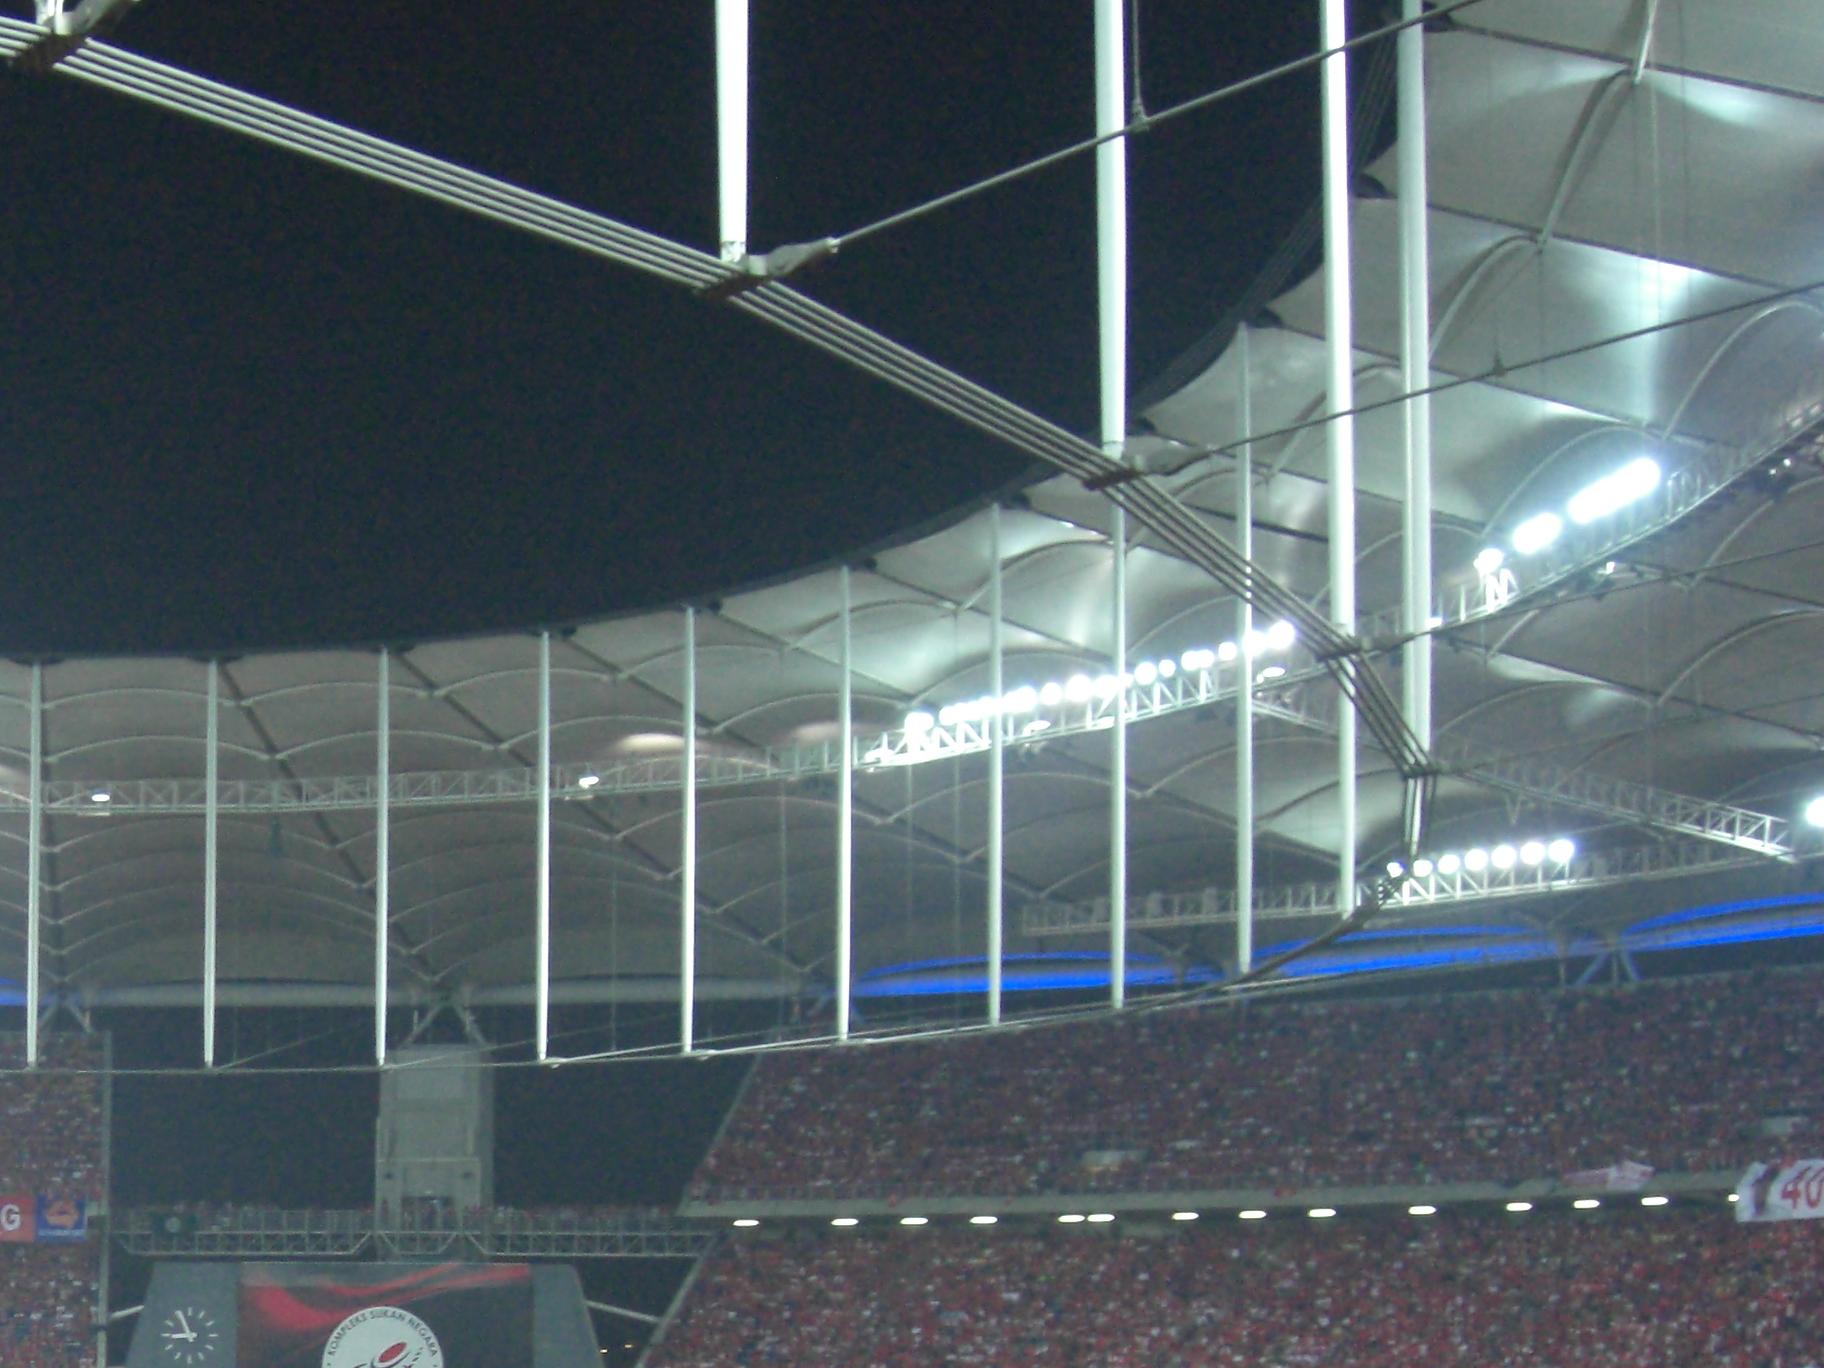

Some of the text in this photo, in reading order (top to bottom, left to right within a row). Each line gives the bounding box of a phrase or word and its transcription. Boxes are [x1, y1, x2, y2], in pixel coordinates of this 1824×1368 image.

[327, 1310, 438, 1356] KOMPLEKS SUKAN NEGARA
